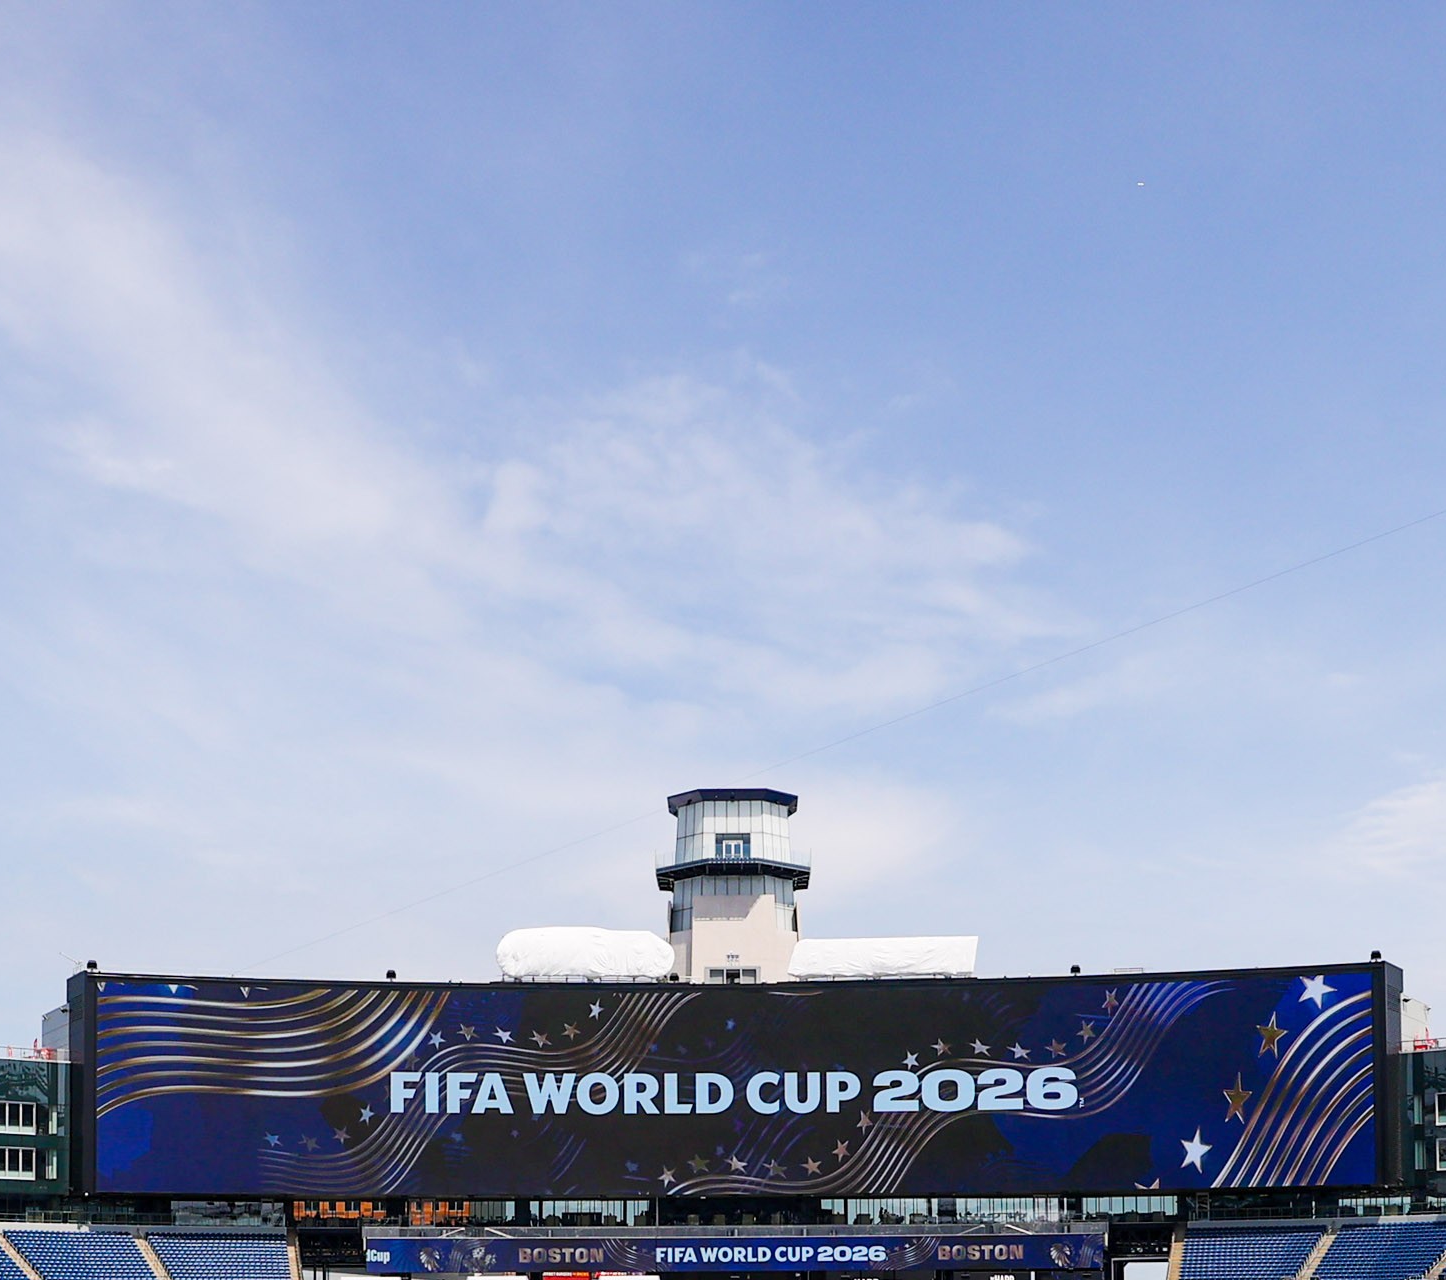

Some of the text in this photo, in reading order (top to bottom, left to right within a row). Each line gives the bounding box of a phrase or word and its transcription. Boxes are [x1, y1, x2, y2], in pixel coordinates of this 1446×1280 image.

[390, 1066, 1079, 1115] FIFA WORLD CUP 2026
[518, 1247, 604, 1264] BOSTON
[655, 1244, 886, 1263] FIFA WORLD CUP 2026
[937, 1244, 1024, 1261] BOSTON
